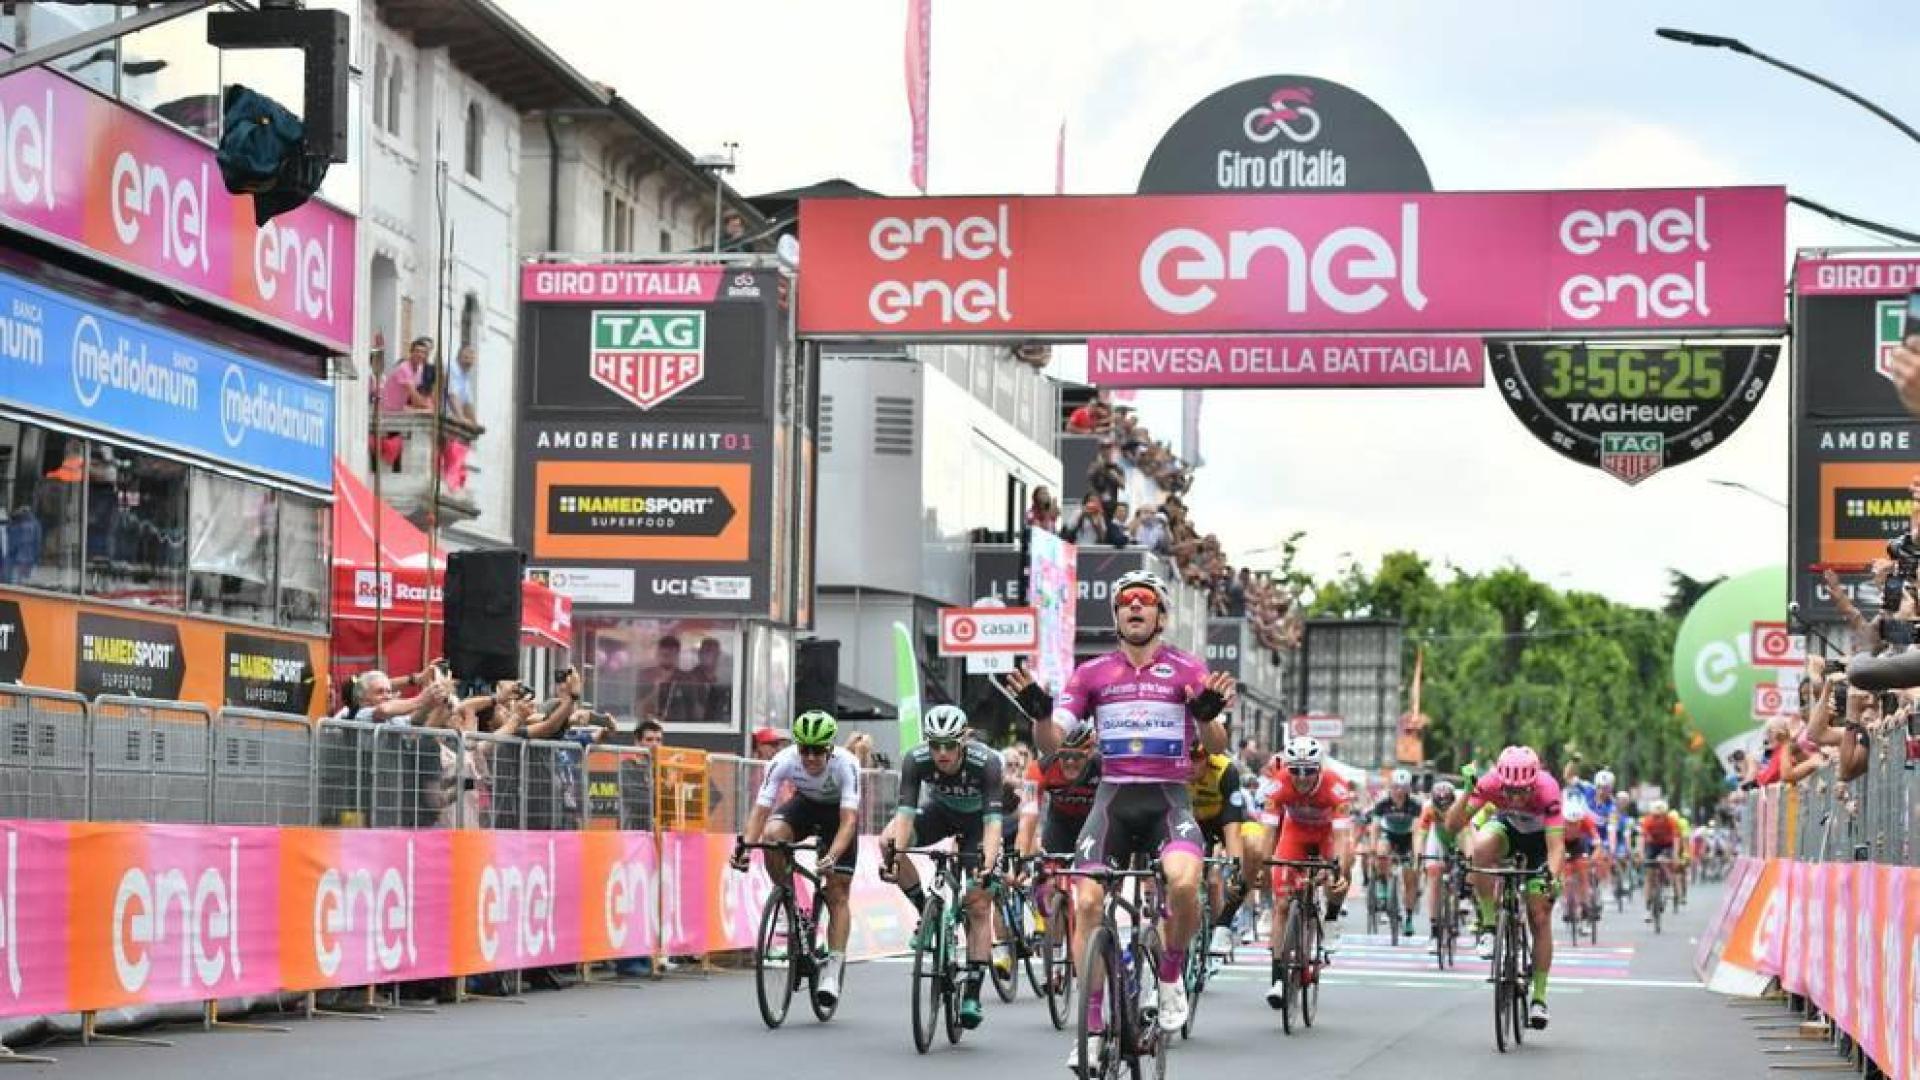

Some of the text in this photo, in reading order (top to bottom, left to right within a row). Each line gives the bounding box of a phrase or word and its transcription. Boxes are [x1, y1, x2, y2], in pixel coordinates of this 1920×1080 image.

[1217, 149, 1347, 188] Giro d'Italia
[111, 152, 209, 272] enel
[869, 204, 1012, 261] enel
[1559, 196, 1711, 254] enel
[254, 221, 335, 323] enel
[1140, 202, 1429, 314] enel
[1818, 265, 1881, 288] GIRO
[536, 271, 595, 295] GIRO
[602, 270, 702, 295] D'ITALIA
[869, 267, 1012, 324] enel
[1559, 260, 1711, 319] enel
[602, 318, 694, 346] TAG
[78, 336, 198, 411] mediolanum
[599, 356, 695, 400] HEUER
[1097, 347, 1472, 373] NERVESA DELLA BATTAGLIA
[1543, 349, 1724, 399] 3:56:25
[225, 383, 326, 448] mediolanum
[537, 432, 751, 450] AMORE INFINIT01
[1607, 435, 1657, 451] TAG
[1820, 431, 1911, 450] AMORE
[577, 497, 708, 516] NAMEDSPORT
[590, 517, 676, 529] SUPERFOOD
[652, 577, 688, 596] UCI
[981, 621, 1031, 637] casa.it
[92, 633, 174, 670] NAMEDSPORT
[239, 653, 304, 683] NAMEDSPORT
[112, 836, 242, 993] enel
[313, 837, 418, 978] enel
[477, 838, 557, 962] enel
[605, 839, 684, 949] enel
